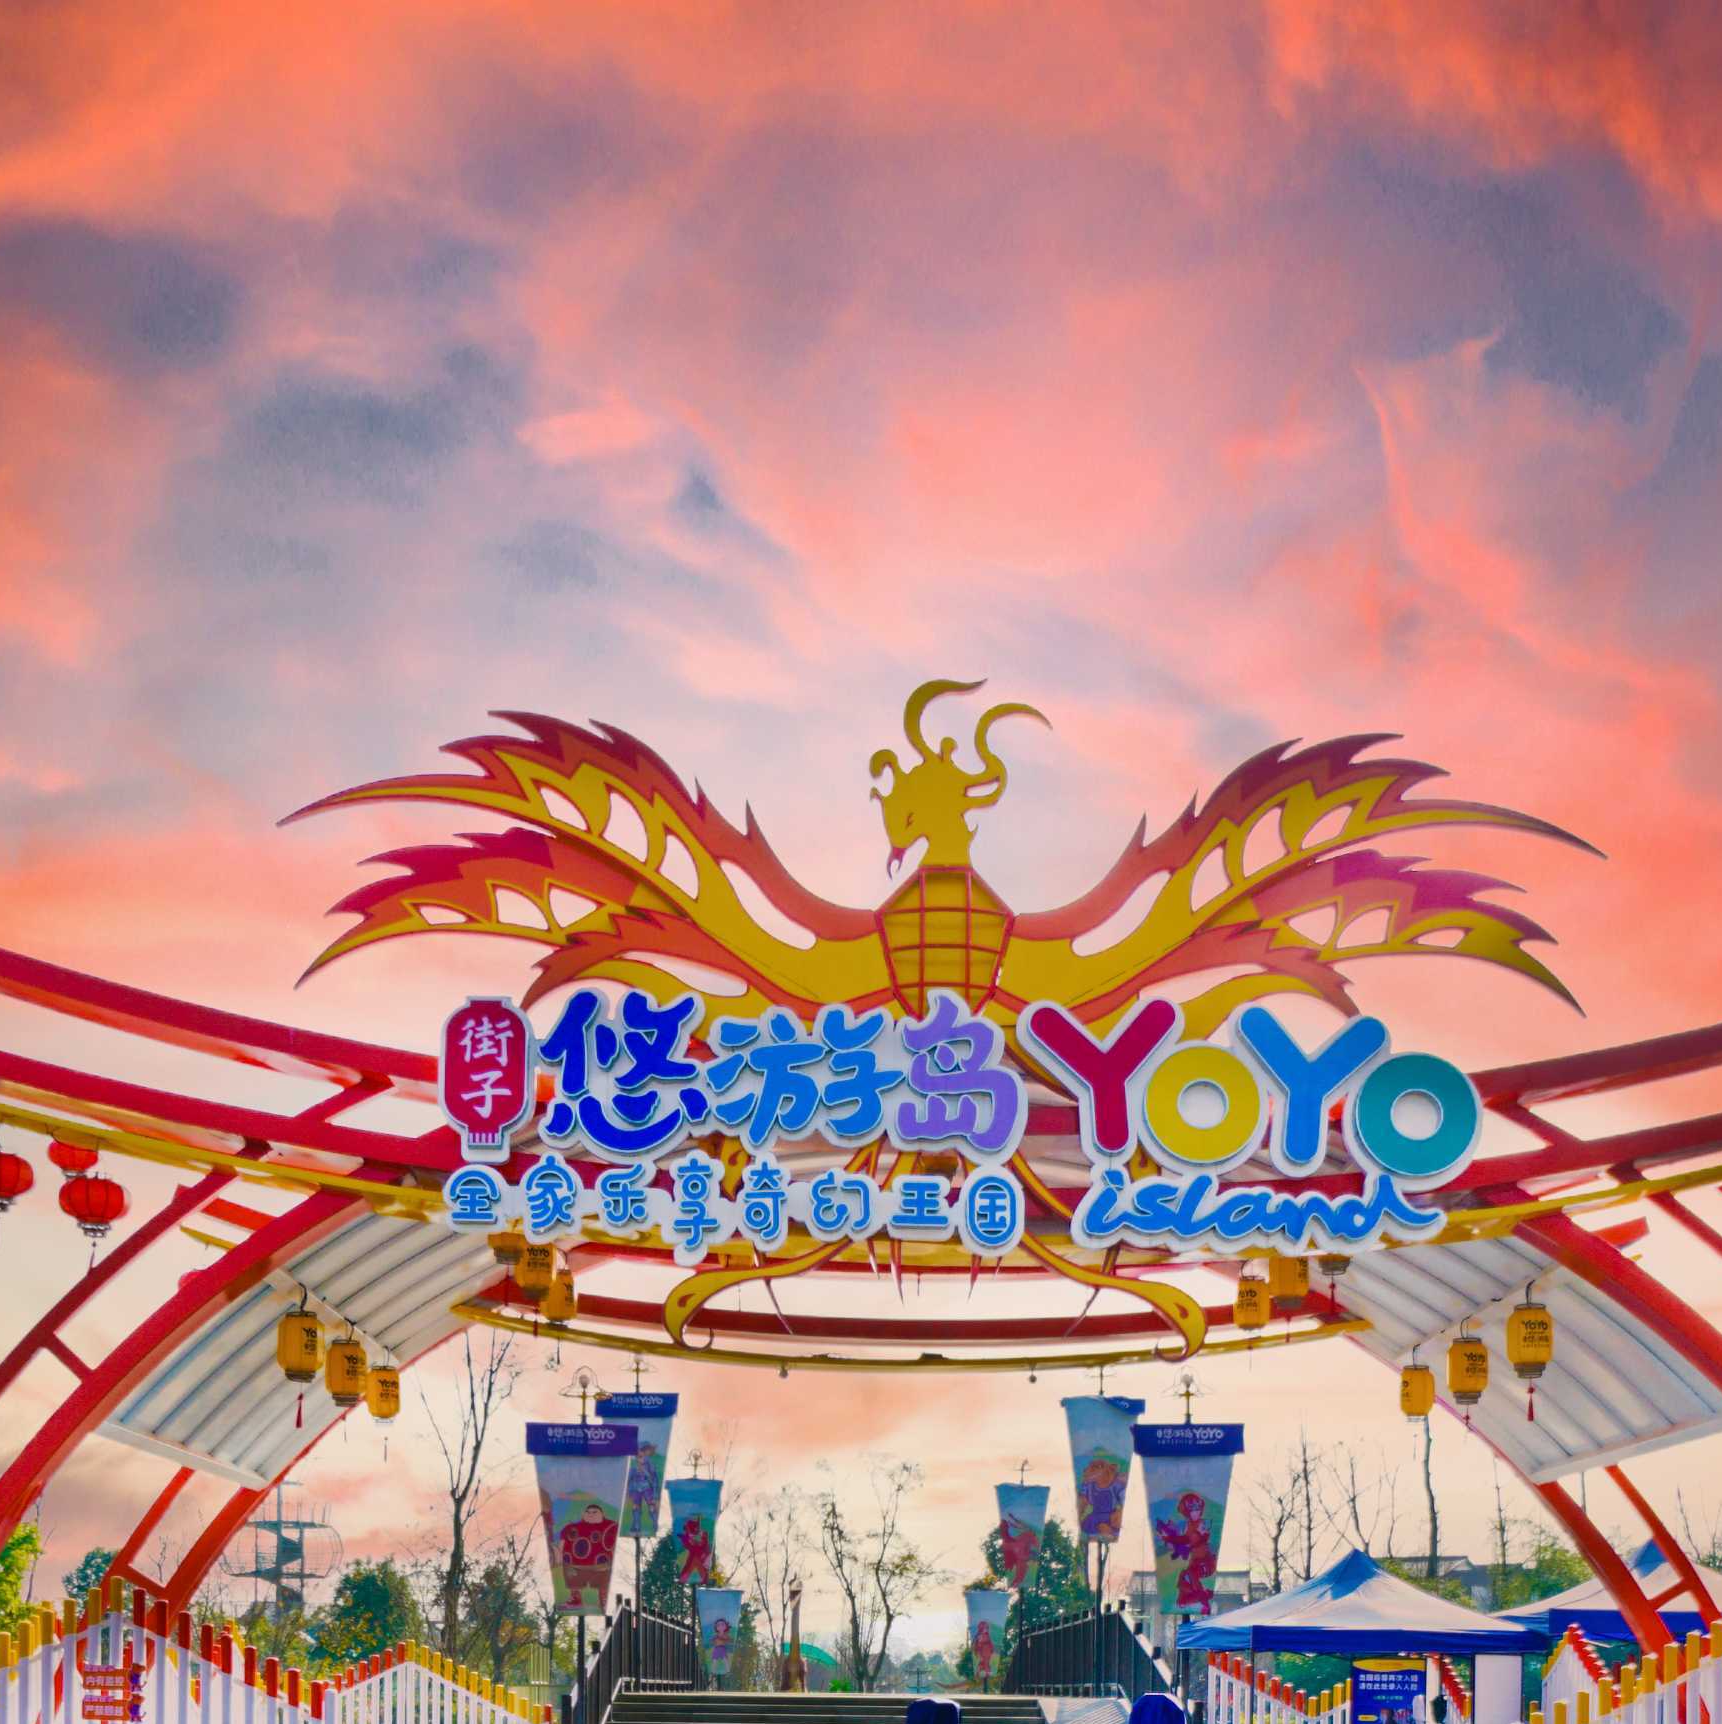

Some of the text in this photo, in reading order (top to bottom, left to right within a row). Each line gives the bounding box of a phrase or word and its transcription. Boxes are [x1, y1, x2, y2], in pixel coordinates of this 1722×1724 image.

[458, 1015, 515, 1119] 街子
[538, 991, 1019, 1152] 悠游岛
[449, 1155, 1018, 1248] 全家乐享奇幻王国
[1083, 1168, 1444, 1242] island
